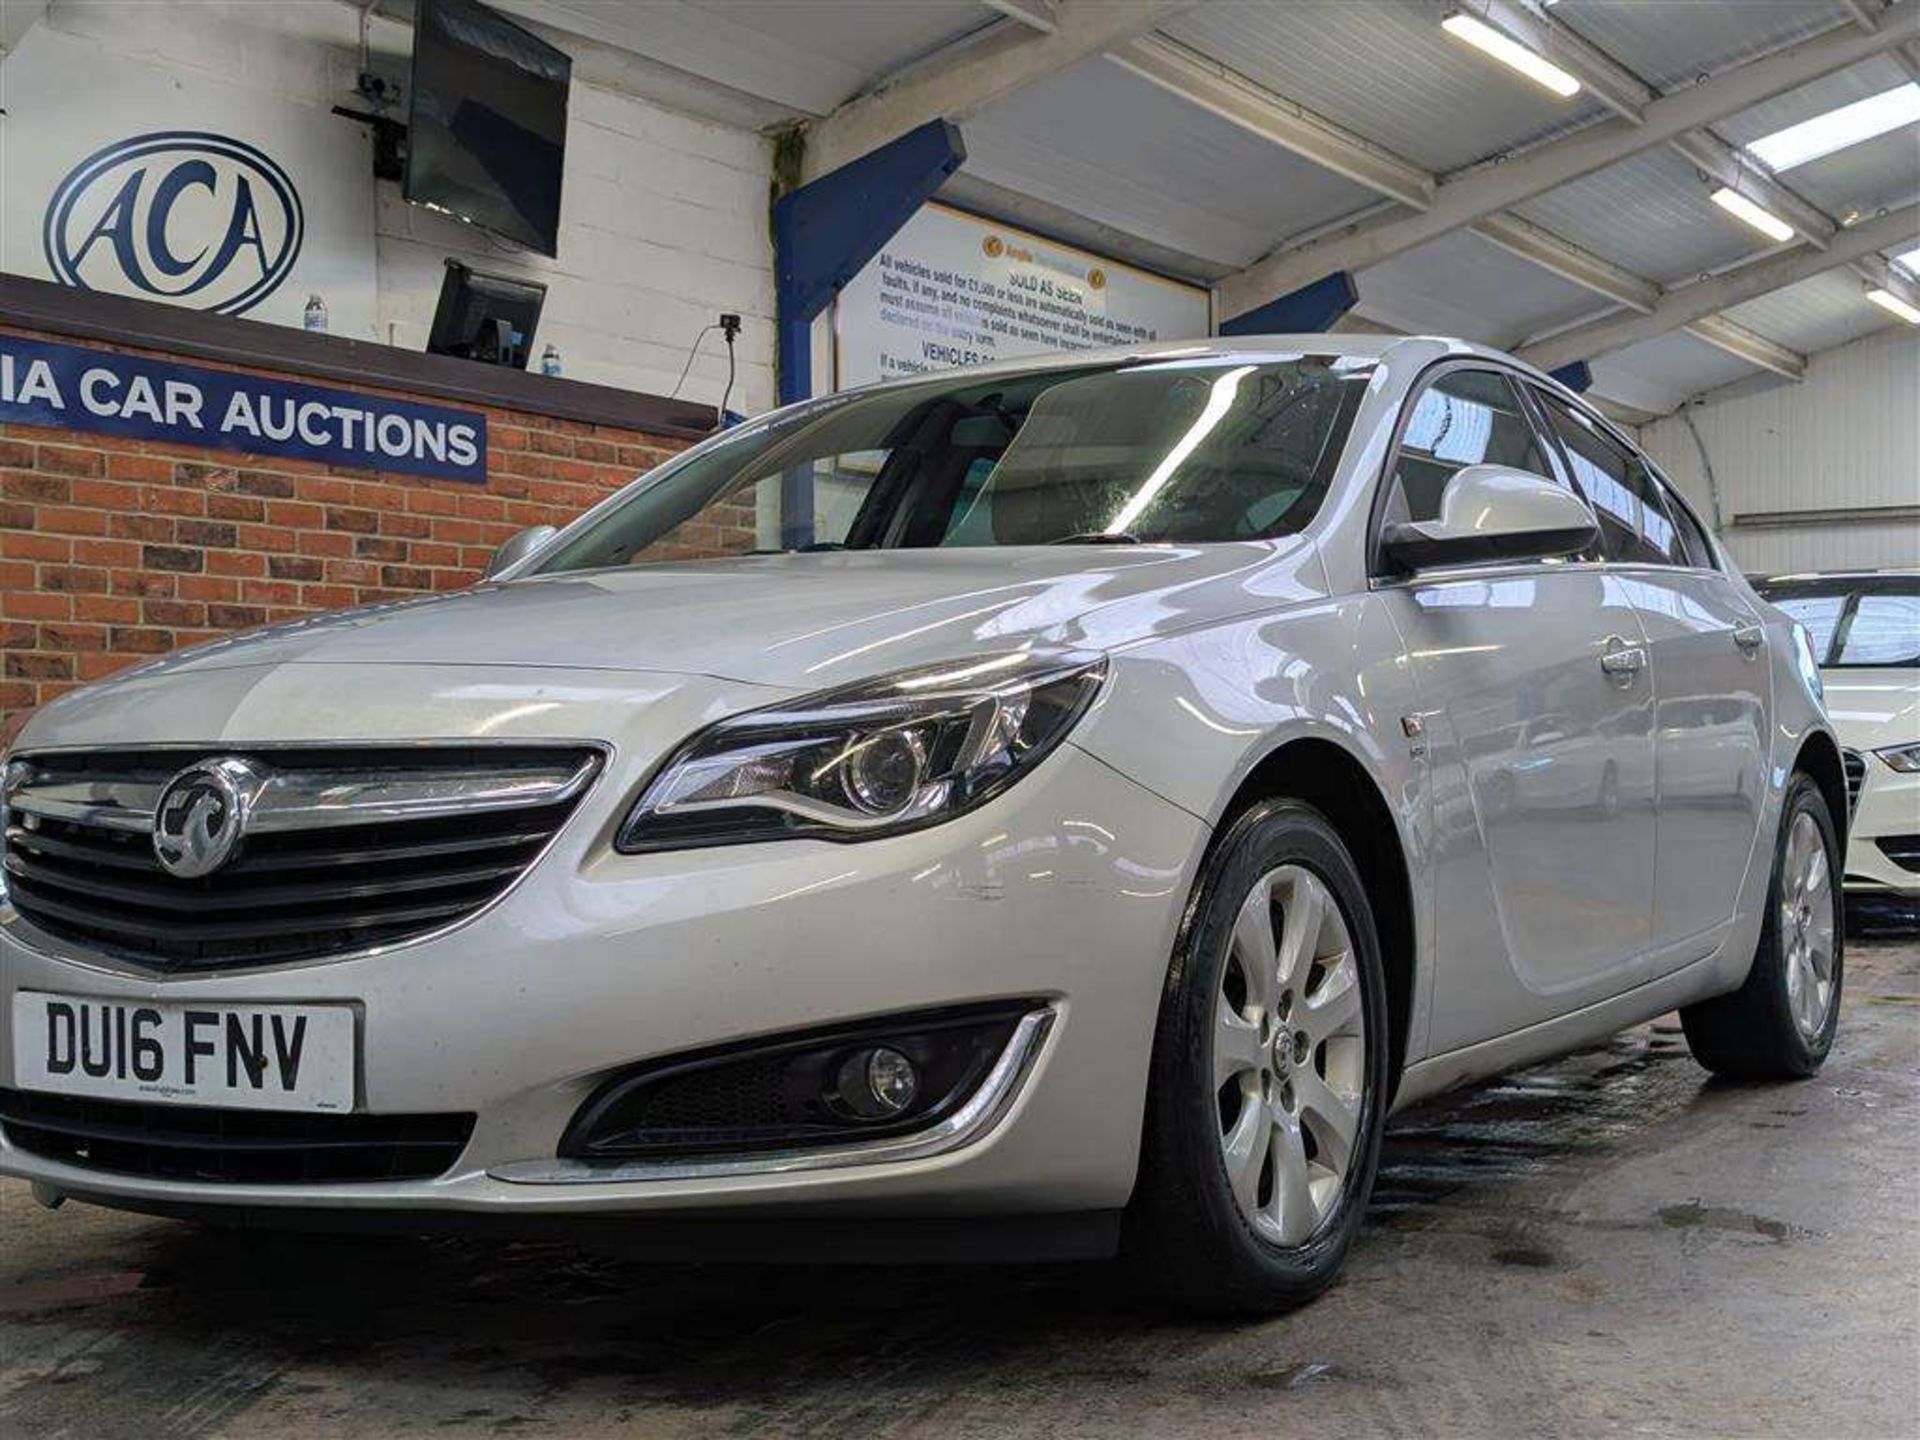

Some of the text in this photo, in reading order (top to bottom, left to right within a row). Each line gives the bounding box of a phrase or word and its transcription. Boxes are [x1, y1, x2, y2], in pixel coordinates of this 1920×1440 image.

[68, 158, 272, 297] ACA
[880, 253, 892, 268] All
[894, 260, 931, 280] vehicles
[933, 271, 952, 285] sold
[954, 273, 966, 288] for
[997, 288, 1005, 299] or
[1007, 289, 1023, 306] less
[1025, 296, 1037, 309] are
[1039, 301, 1087, 326] automatically
[1089, 314, 1104, 328] sold
[1116, 322, 1131, 335] seen
[881, 292, 902, 307] must
[905, 299, 939, 315] assume
[991, 319, 1007, 333] sold
[1009, 325, 1018, 336] as
[1020, 328, 1039, 341] seen
[913, 280, 919, 293] if
[941, 290, 957, 304] and
[959, 296, 970, 308] no
[973, 299, 1016, 321] complaints
[1018, 310, 1060, 331] whatsoever
[1062, 321, 1080, 335] shall
[1081, 327, 1090, 338] be
[1040, 279, 1053, 297] AS
[881, 352, 888, 367] If
[889, 357, 896, 369] a
[922, 340, 979, 367] VEHICLES
[79, 368, 203, 429] CAR
[221, 391, 478, 466] AUCTIONS
[46, 1001, 308, 1092] DU16 FNV
